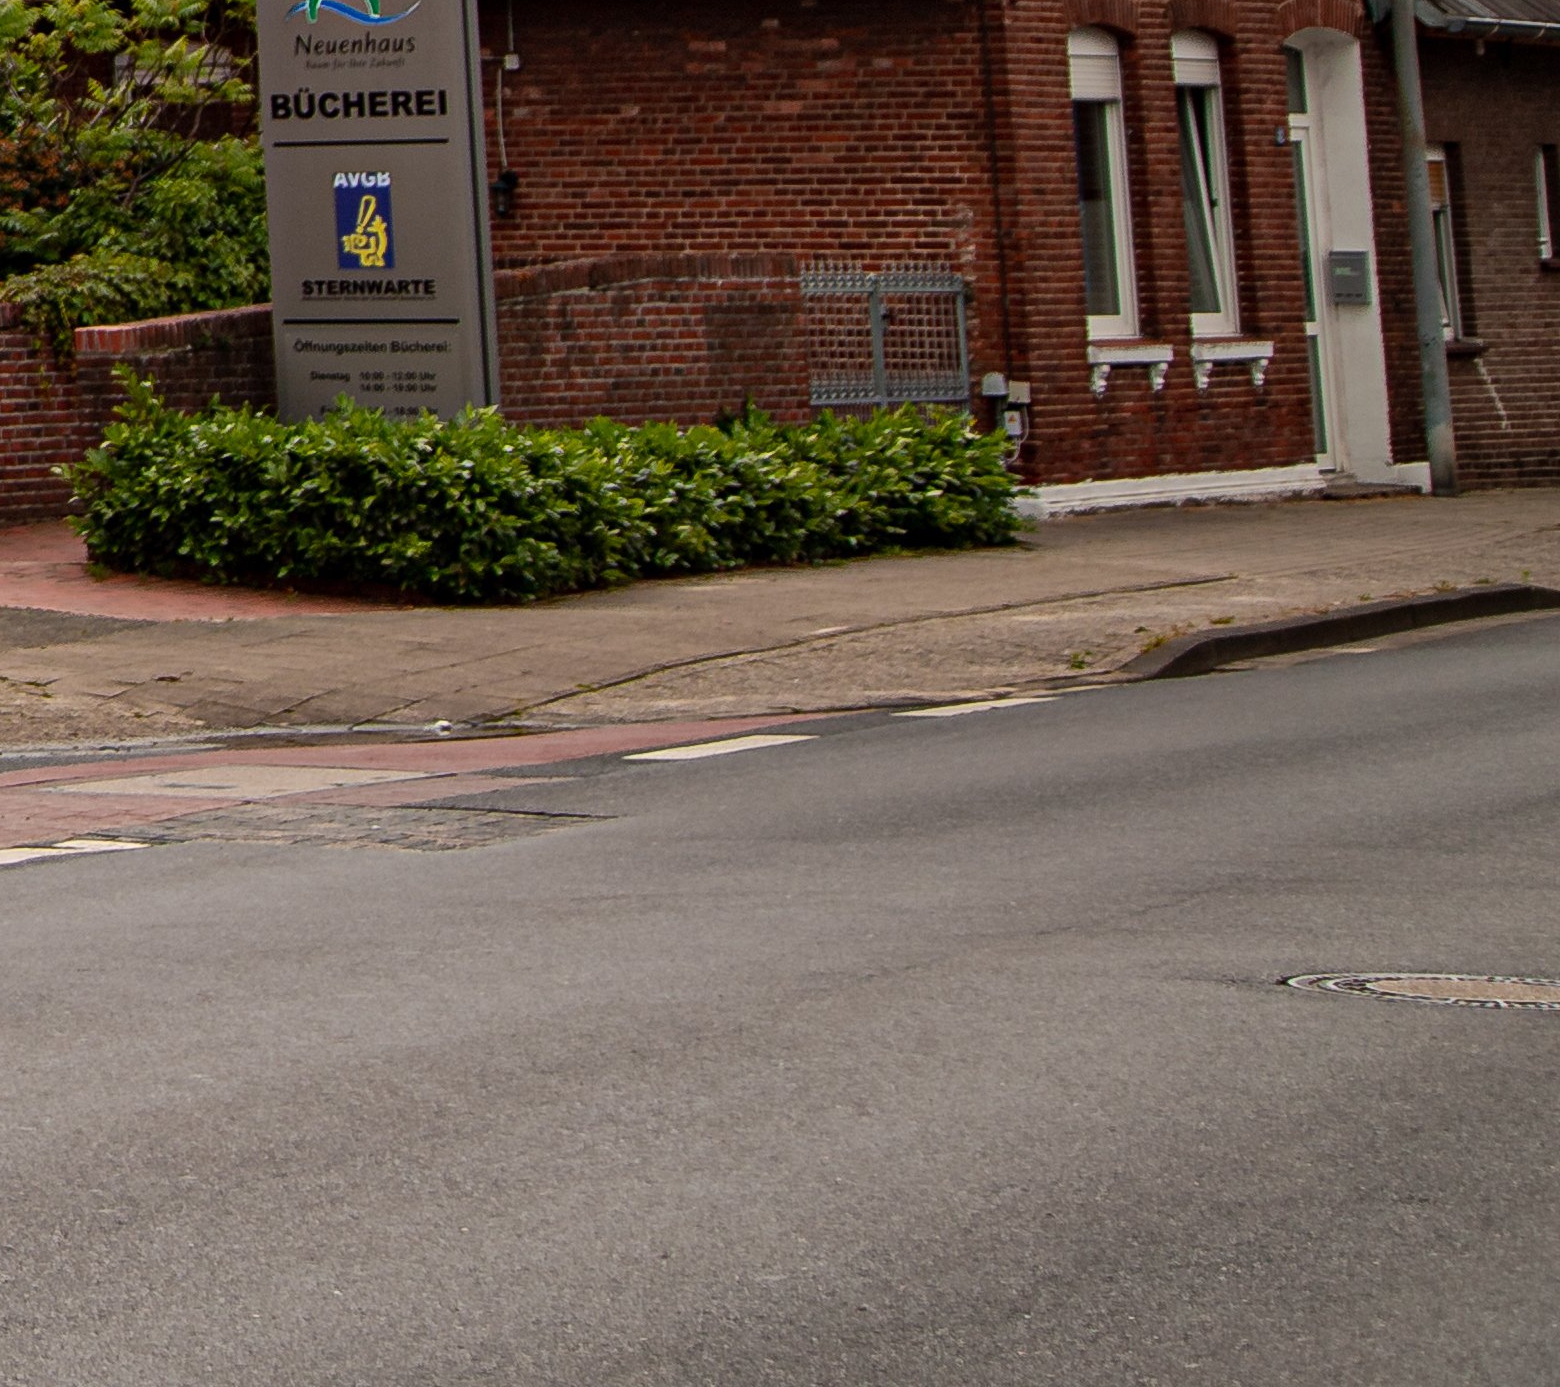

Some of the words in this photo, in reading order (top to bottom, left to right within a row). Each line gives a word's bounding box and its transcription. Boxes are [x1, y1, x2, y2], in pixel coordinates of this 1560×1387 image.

[294, 31, 416, 55] Neuenhaus
[271, 87, 448, 119] BÜCHEREI
[333, 172, 391, 188] AVGB
[302, 279, 436, 295] STERNWARTE
[294, 337, 388, 356] Öffnungszeiten
